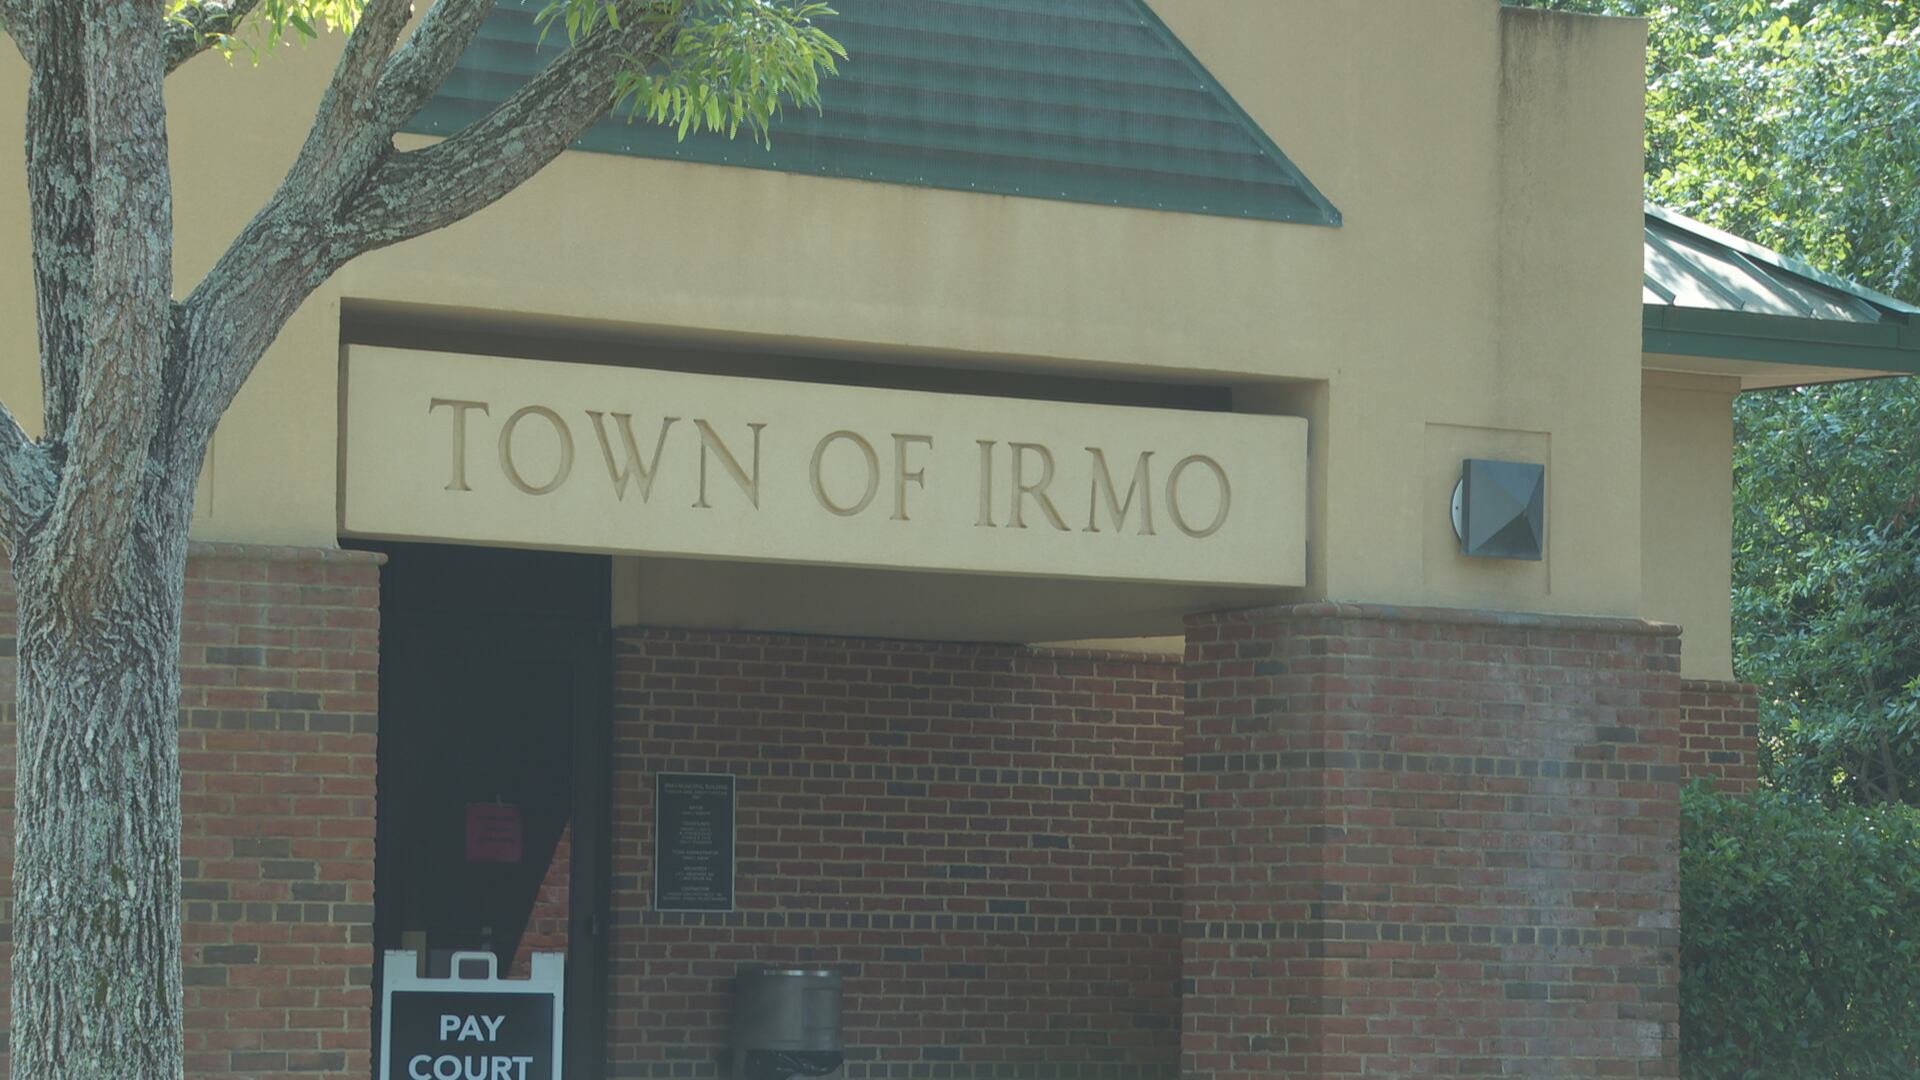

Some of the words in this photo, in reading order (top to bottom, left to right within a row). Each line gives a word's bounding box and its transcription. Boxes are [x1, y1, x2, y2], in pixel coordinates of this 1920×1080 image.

[428, 397, 768, 511] TOWN
[809, 429, 934, 521] OF
[973, 439, 1232, 539] IRMO
[439, 1014, 506, 1042] PAY
[408, 1054, 534, 1080] COURT
